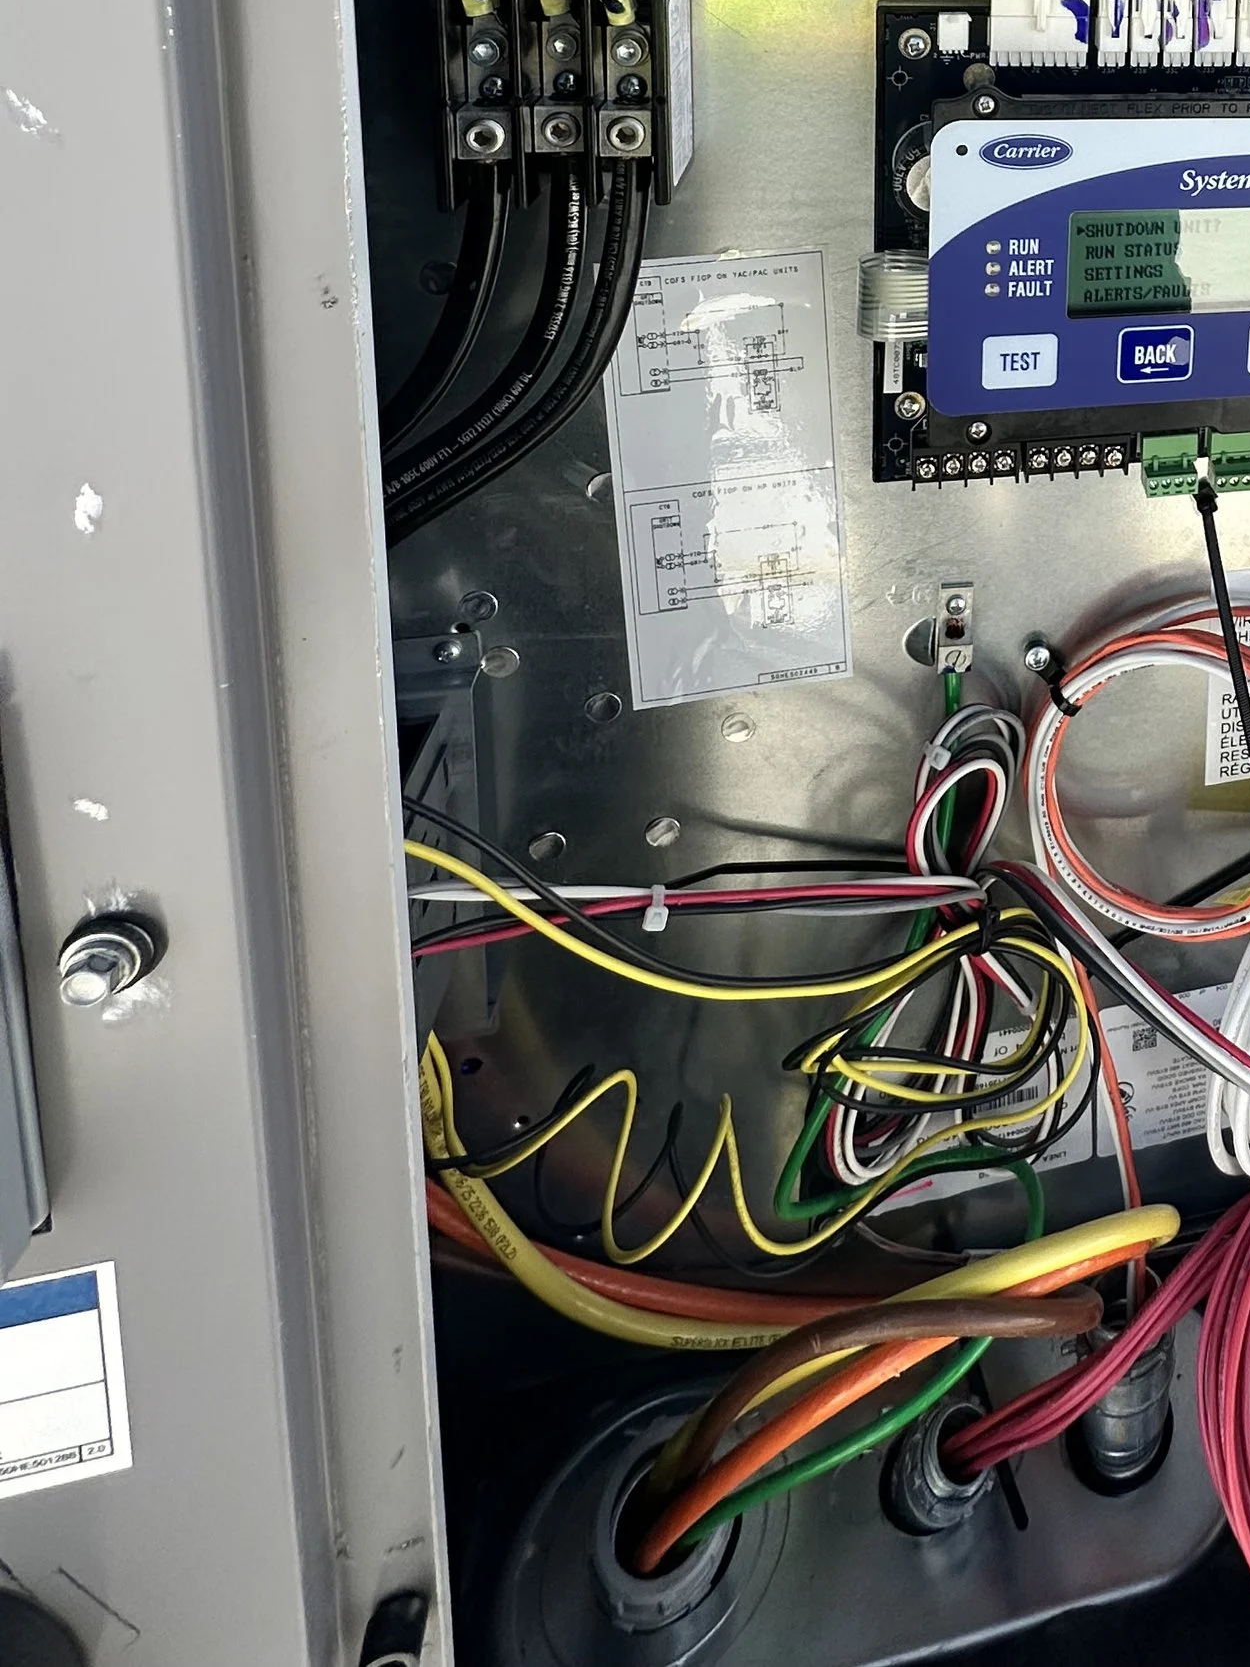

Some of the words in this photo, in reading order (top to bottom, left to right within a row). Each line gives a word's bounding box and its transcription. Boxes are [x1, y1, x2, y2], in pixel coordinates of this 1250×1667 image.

[1127, 104, 1161, 114] FLEX
[1172, 103, 1210, 114] PRIOR
[1221, 103, 1238, 114] TO
[993, 141, 1061, 162] Carrier
[1086, 218, 1165, 238] SHUTDOWN
[1008, 238, 1040, 256] RUN
[1086, 242, 1115, 260] RUN
[1125, 240, 1182, 258] STATUS
[1008, 260, 1054, 276] ALERT
[1084, 263, 1163, 282] SETTINGS
[1008, 280, 1052, 298] FAULT
[1000, 351, 1041, 372] TEST
[1134, 344, 1177, 365] BACK
[87, 1444, 106, 1456] 2.0
